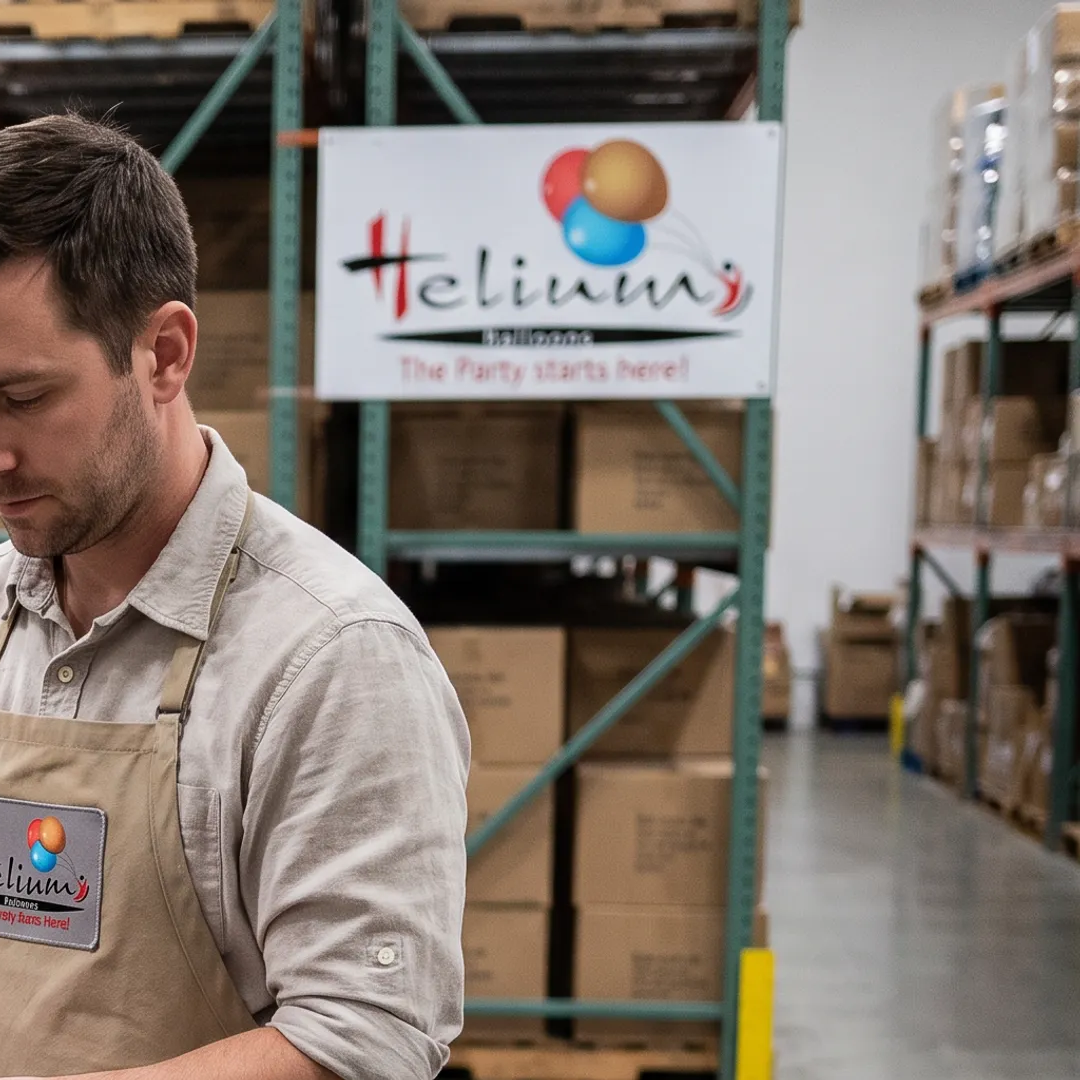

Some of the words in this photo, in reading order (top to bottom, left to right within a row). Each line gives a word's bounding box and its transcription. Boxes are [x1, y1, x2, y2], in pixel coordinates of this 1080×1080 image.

[341, 211, 716, 322] Helium
[400, 355, 445, 382] The
[455, 356, 526, 386] Party
[533, 356, 609, 383] starts
[616, 355, 690, 382] here!
[43, 915, 71, 931] Here!
